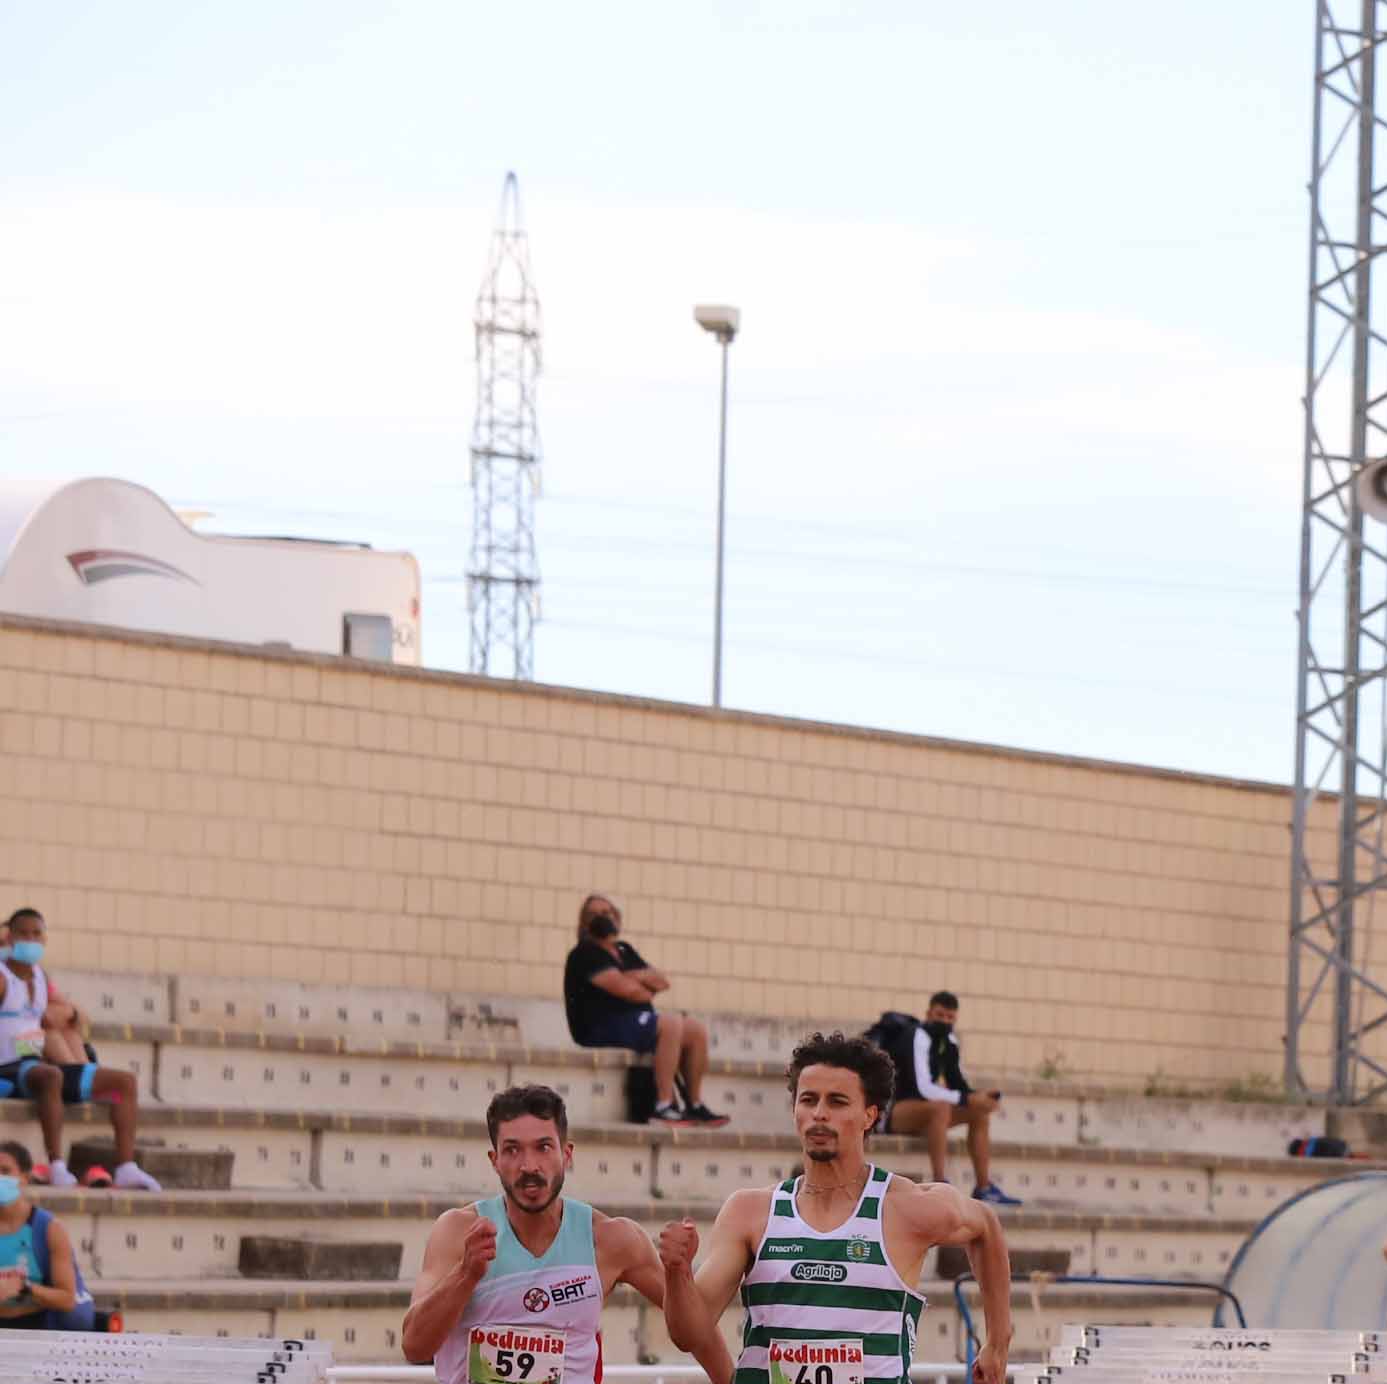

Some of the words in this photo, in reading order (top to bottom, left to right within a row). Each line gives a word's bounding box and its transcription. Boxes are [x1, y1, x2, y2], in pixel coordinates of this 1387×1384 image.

[796, 1265, 843, 1281] Agriloja
[551, 1281, 586, 1302] BAT
[471, 1327, 564, 1355] bedunia
[769, 1343, 862, 1364] bedunia
[495, 1350, 535, 1379] 59
